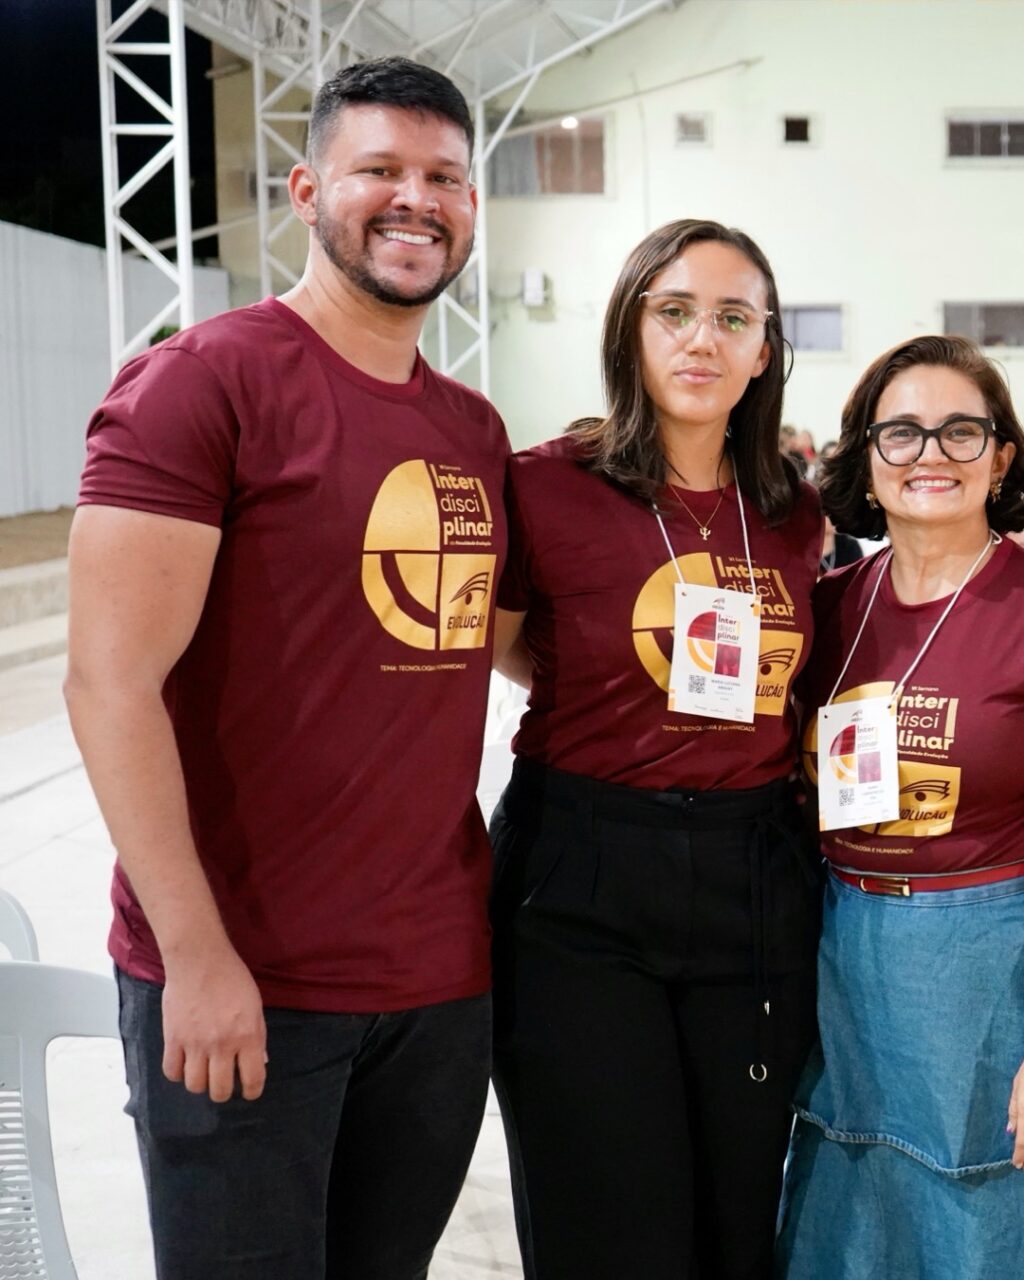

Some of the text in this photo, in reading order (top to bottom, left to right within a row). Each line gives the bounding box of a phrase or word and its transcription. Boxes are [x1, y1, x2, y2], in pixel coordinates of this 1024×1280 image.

[429, 463, 475, 490] Inter
[441, 492, 480, 513] disci
[443, 516, 493, 545] plinar
[716, 556, 771, 579] Inter
[718, 613, 737, 625] Inter
[760, 604, 795, 618] nar
[717, 632, 740, 643] plinar
[898, 730, 954, 751] linar
